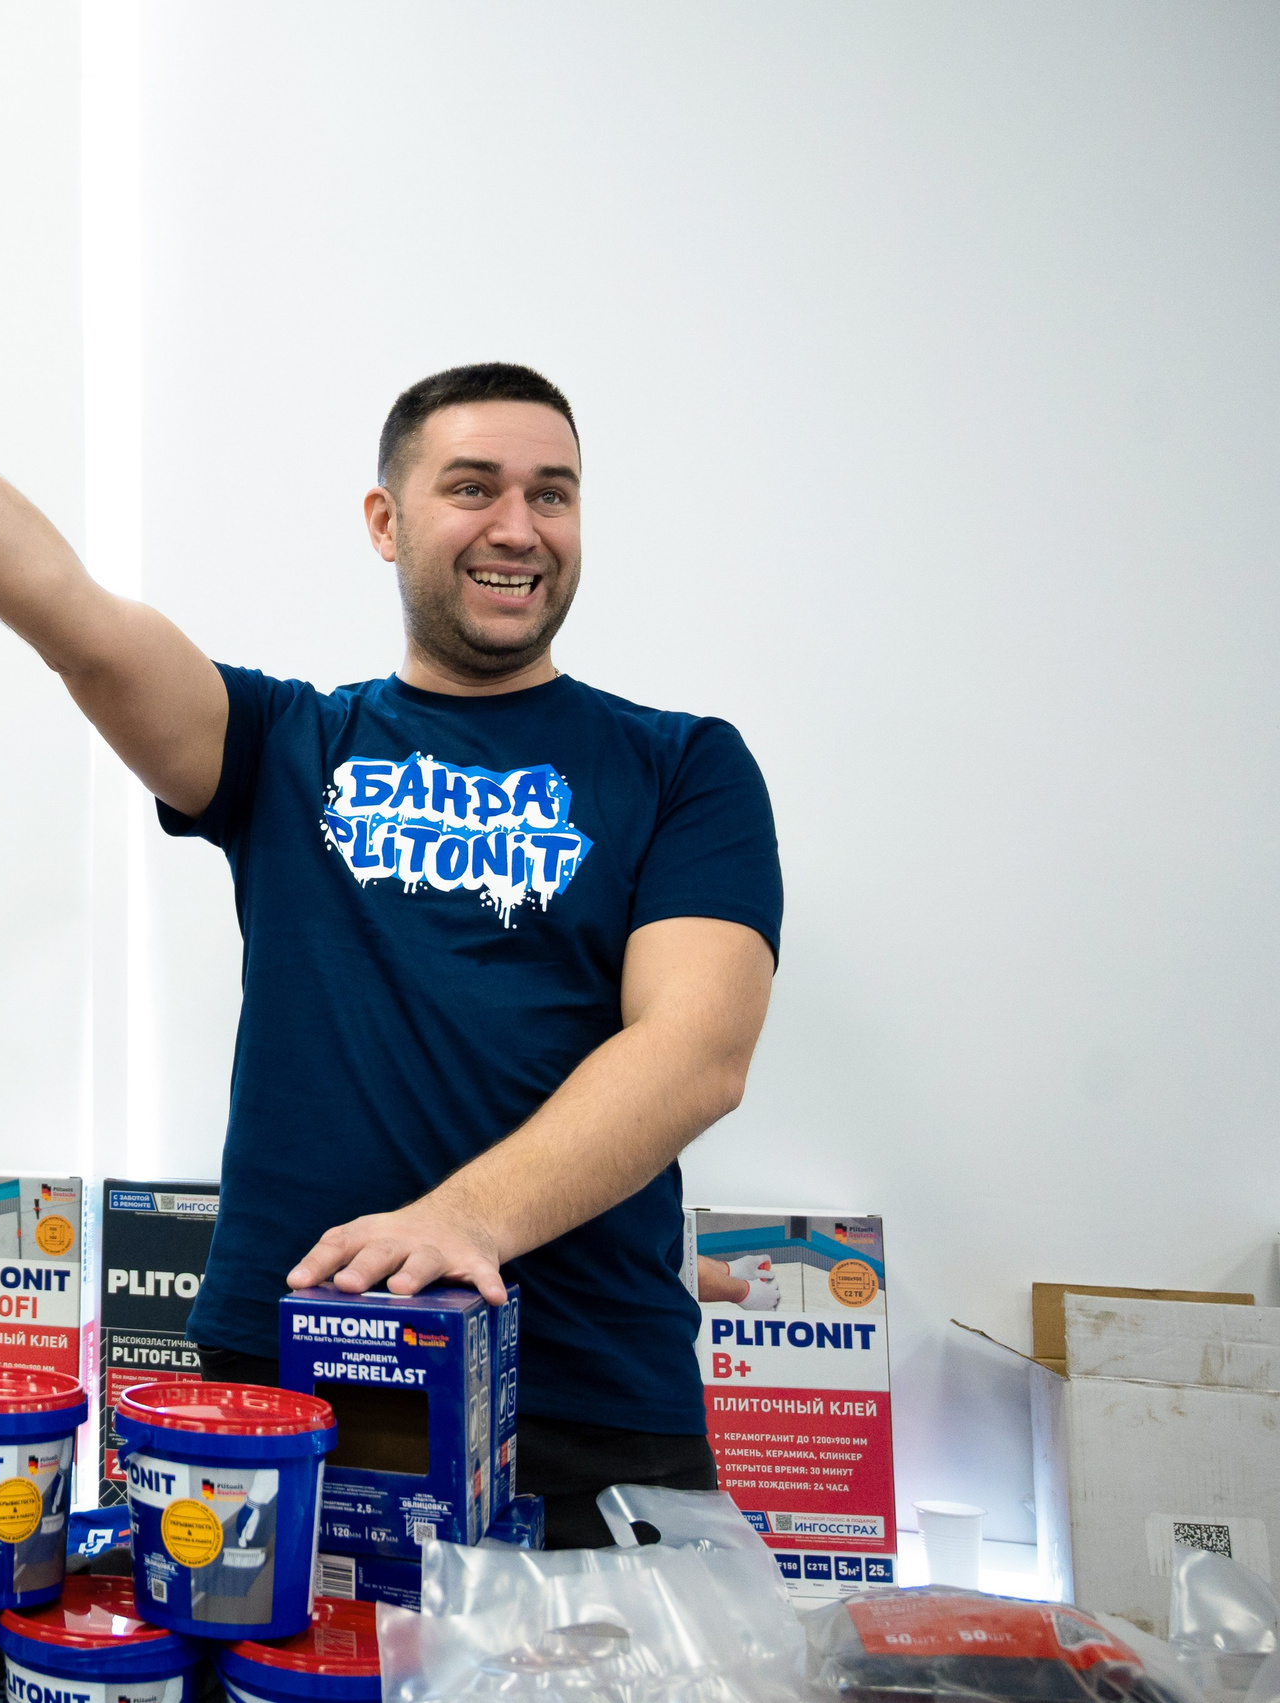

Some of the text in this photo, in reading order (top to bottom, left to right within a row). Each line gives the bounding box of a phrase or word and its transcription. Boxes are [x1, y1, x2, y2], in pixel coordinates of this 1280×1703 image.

[349, 758, 557, 827] БАНДА
[177, 1202, 220, 1212] ИНГОСС
[292, 1314, 400, 1340] PLITONIT
[30, 1331, 68, 1349] КЛЕЙ
[418, 1333, 450, 1341] Deutsche
[711, 1318, 876, 1350] PLITONIT
[112, 1336, 198, 1348] ВЫСОКОЭЛАСТИЧНЫ
[333, 1337, 396, 1347] ПРОФЕССИОНАЛОМ
[418, 1339, 447, 1348] Qualität
[341, 1352, 398, 1364] ГИДРОЛЕНТА
[312, 1362, 427, 1384] SUPERELAST
[713, 1397, 877, 1417] ПЛИТОЧНЫЙ КЛЕЙ
[724, 1432, 794, 1443] КЕРАМОГРАНИТ
[796, 1435, 809, 1444] ДО
[852, 1438, 868, 1446] ММ
[724, 1448, 862, 1461] КАМЕНЬ, КЕРАМИКА, КЛИНКЕР
[725, 1464, 853, 1476] ОТКРЫТОЕ ВРЕМЯ: 30 МИНУТ
[130, 1461, 176, 1495] ONIT
[725, 1479, 849, 1492] ВРЕМЯ ХОЖДЕНИЯ: 24 ЧАСА
[402, 1500, 448, 1511] ОБЛИЦОВКА
[794, 1522, 878, 1535] ИНГОССТРАХ
